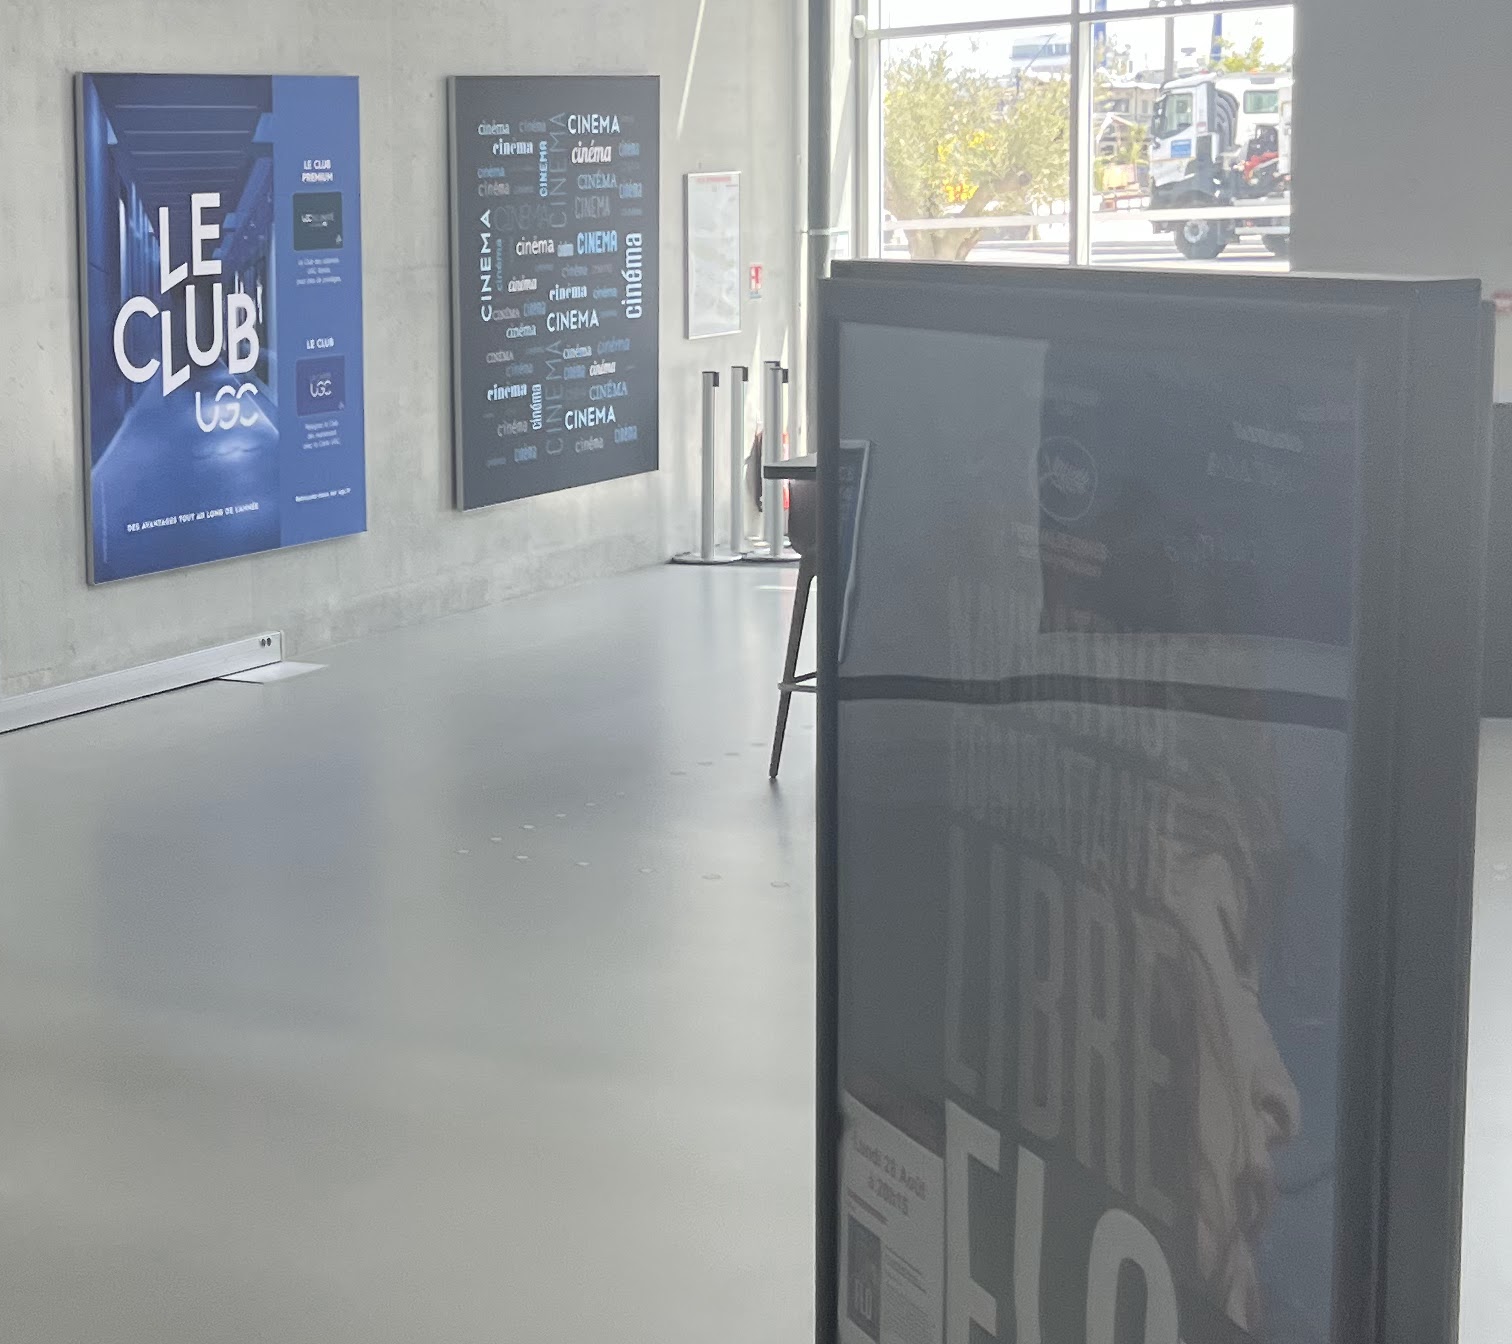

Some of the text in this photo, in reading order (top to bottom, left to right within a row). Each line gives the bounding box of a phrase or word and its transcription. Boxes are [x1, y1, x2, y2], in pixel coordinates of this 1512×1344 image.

[567, 114, 620, 135] CINEMA
[549, 112, 568, 228] CINEMA
[571, 140, 612, 164] cinéma
[159, 192, 222, 294] LE
[515, 235, 555, 256] cinéma
[577, 230, 618, 255] CINEMA
[480, 209, 493, 322] CINEMA
[621, 232, 642, 319] cinéma
[113, 282, 260, 397] CLUB
[546, 309, 600, 333] CINEMA
[316, 337, 335, 349] CLUB
[309, 379, 332, 398] UGC
[545, 340, 563, 455] CINEMA
[195, 383, 259, 433] UGC
[565, 405, 616, 430] CINEMA
[945, 824, 1180, 1226] LIBRE
